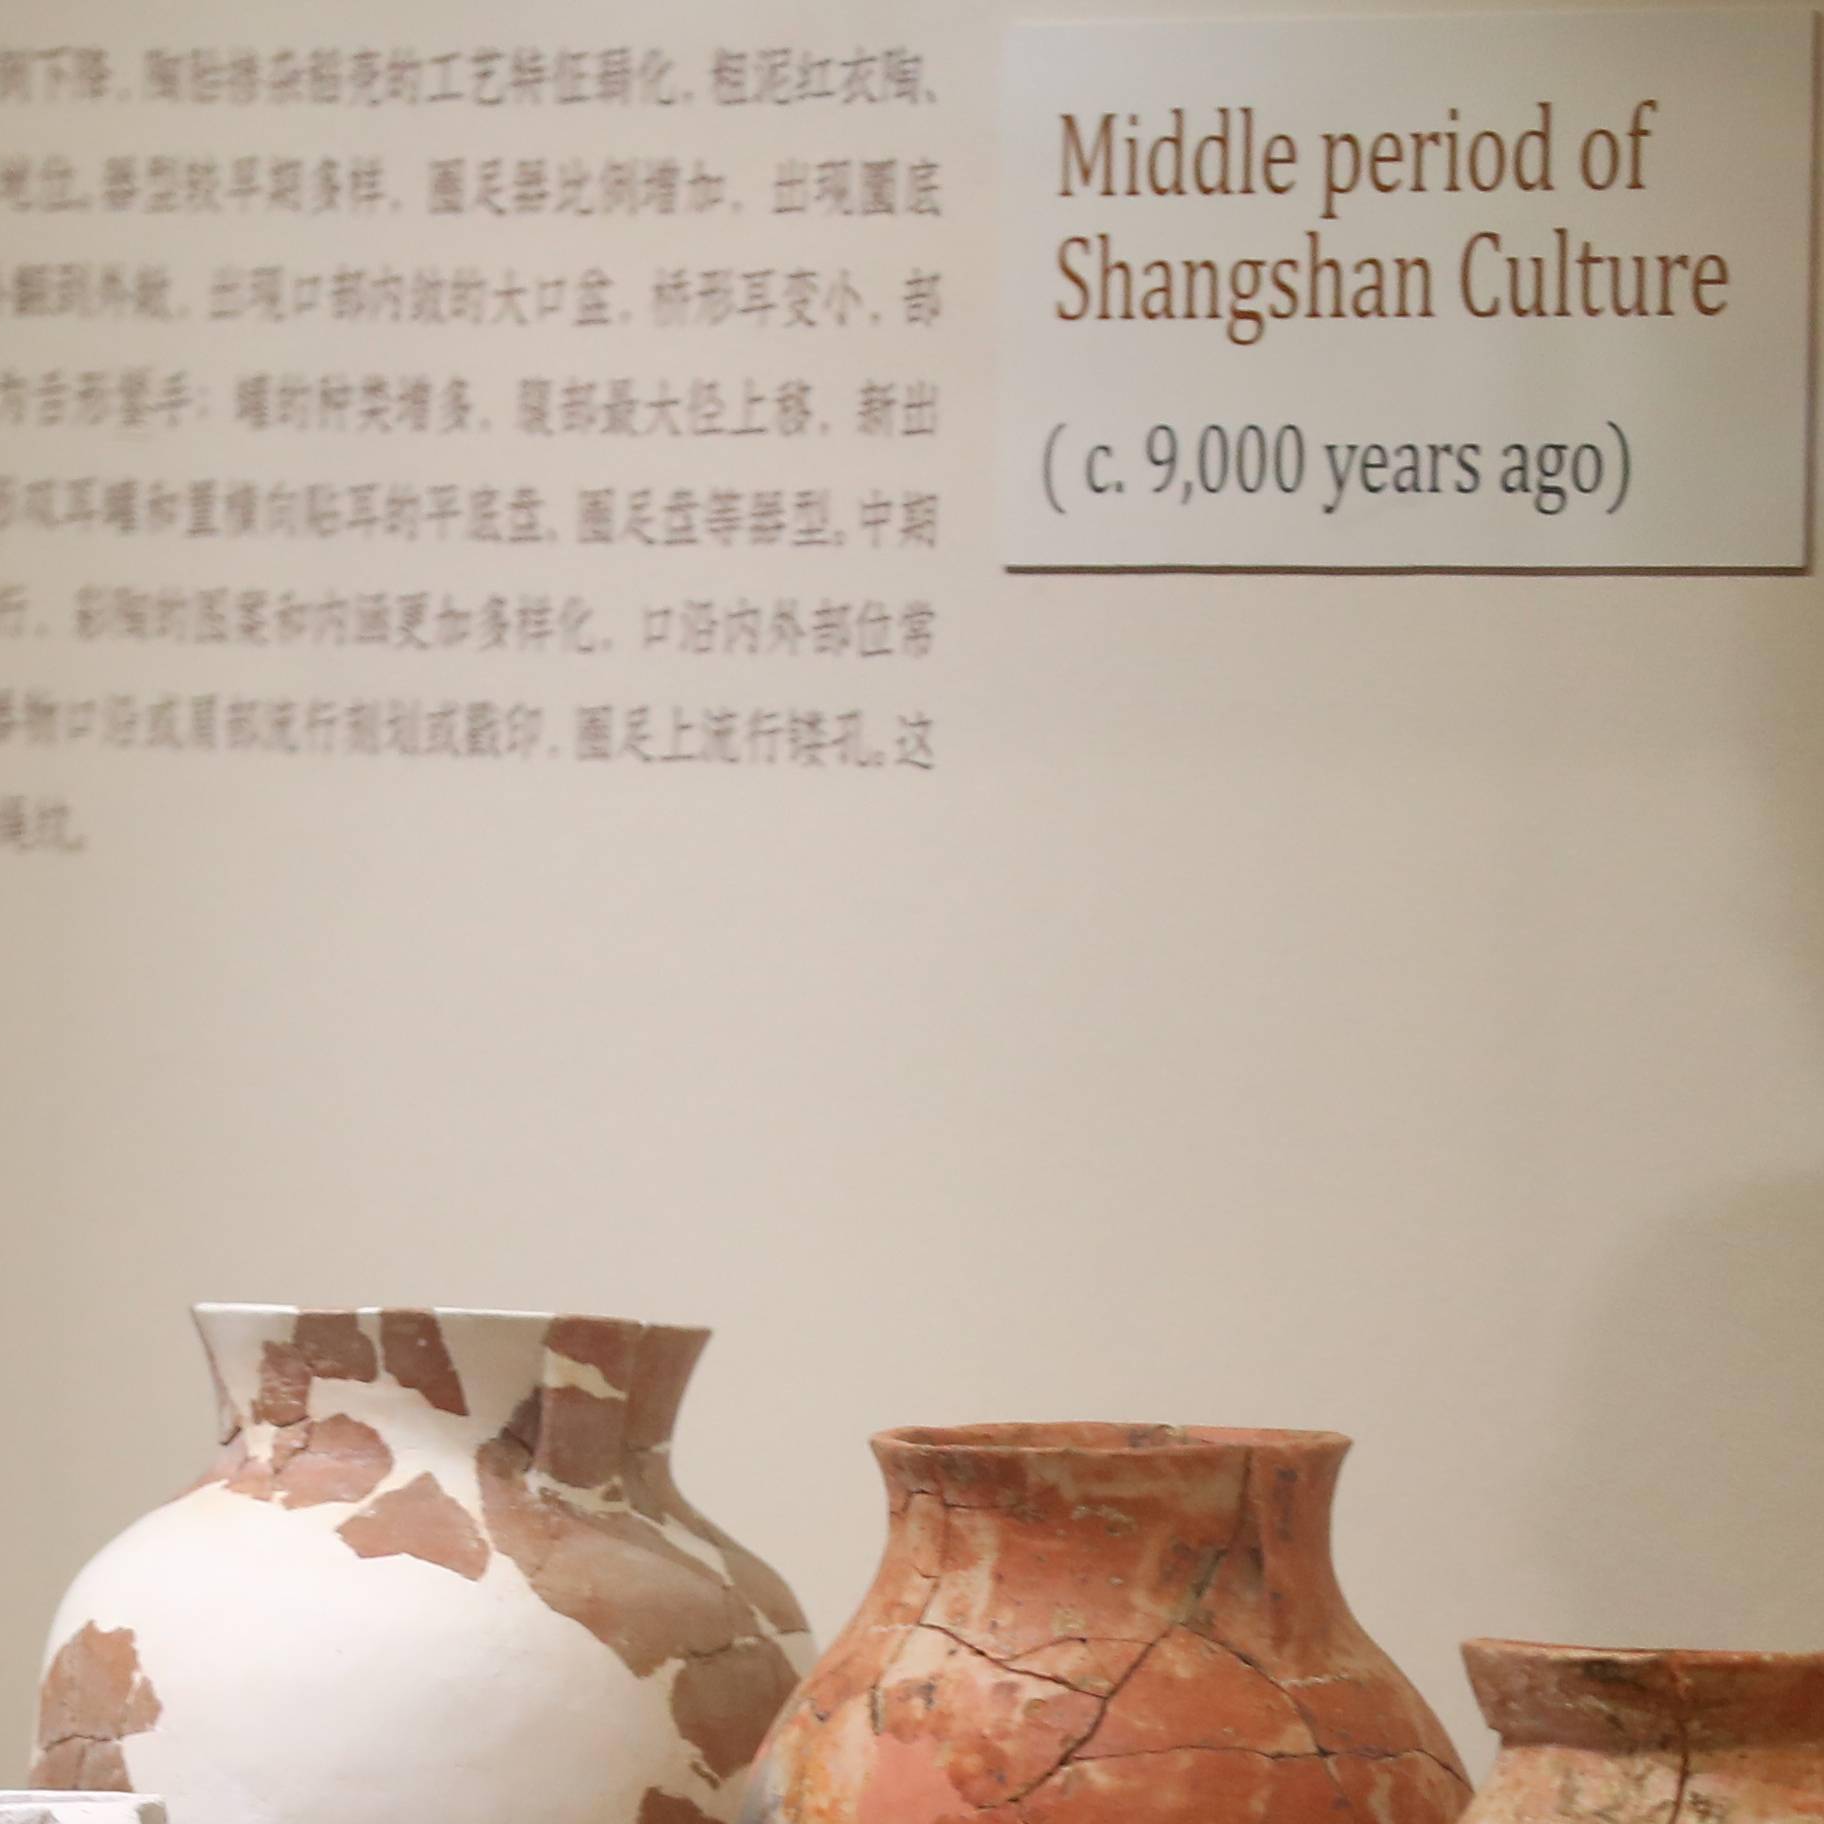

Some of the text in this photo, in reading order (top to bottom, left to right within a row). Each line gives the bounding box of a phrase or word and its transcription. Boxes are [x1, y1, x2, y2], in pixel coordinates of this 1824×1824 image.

[1058, 98, 1660, 220] Middle period of
[1054, 226, 1731, 347] Shangshan Culture
[1143, 422, 1307, 506] 9,000
[1321, 441, 1483, 516] years
[1498, 419, 1633, 517] ago)
